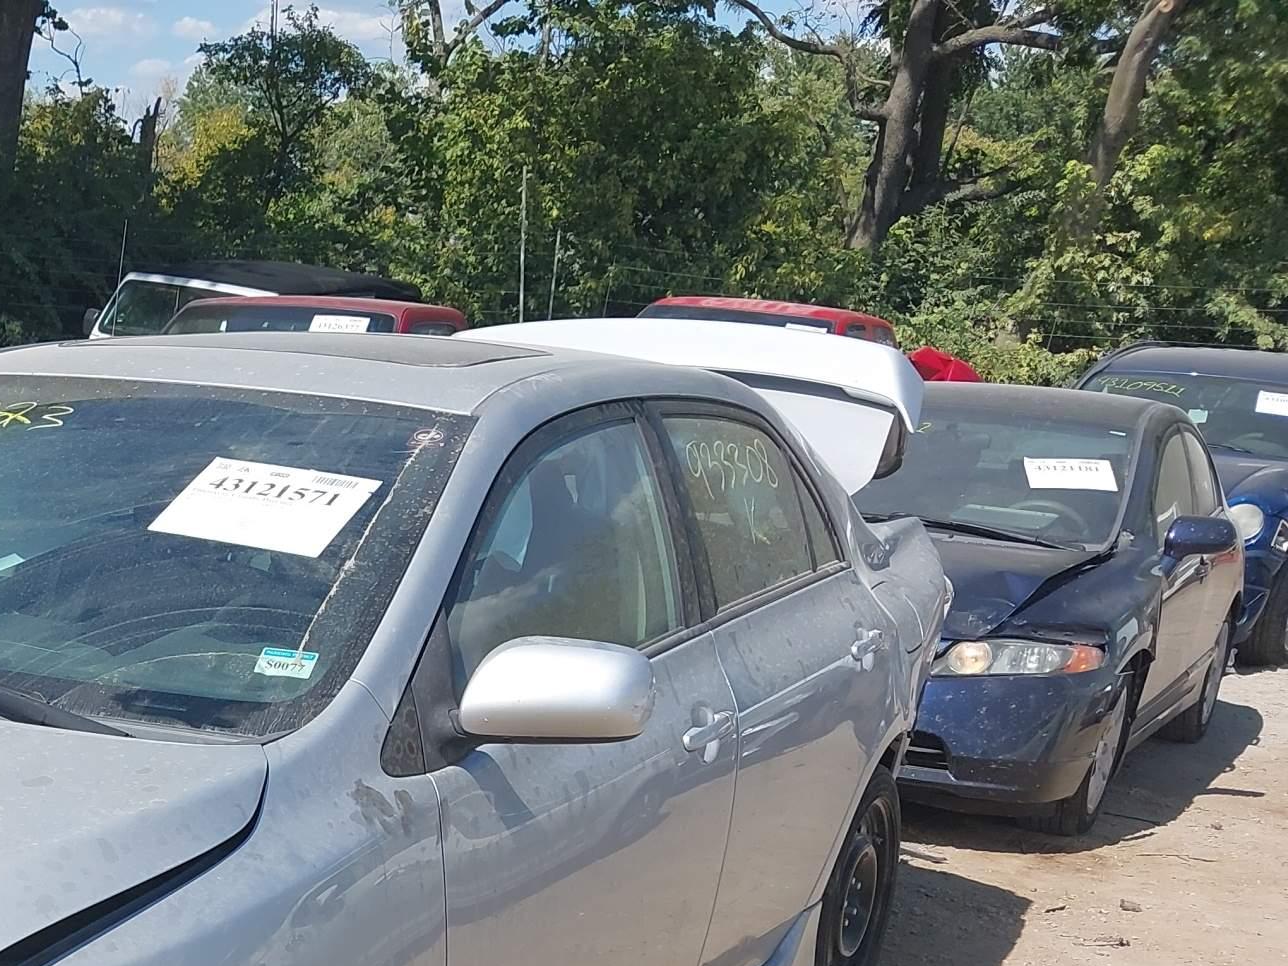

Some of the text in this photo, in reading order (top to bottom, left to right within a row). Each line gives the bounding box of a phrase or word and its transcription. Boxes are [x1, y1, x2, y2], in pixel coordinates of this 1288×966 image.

[685, 438, 779, 500] 933308
[208, 475, 342, 507] 43121571
[264, 660, 306, 673] S0077
